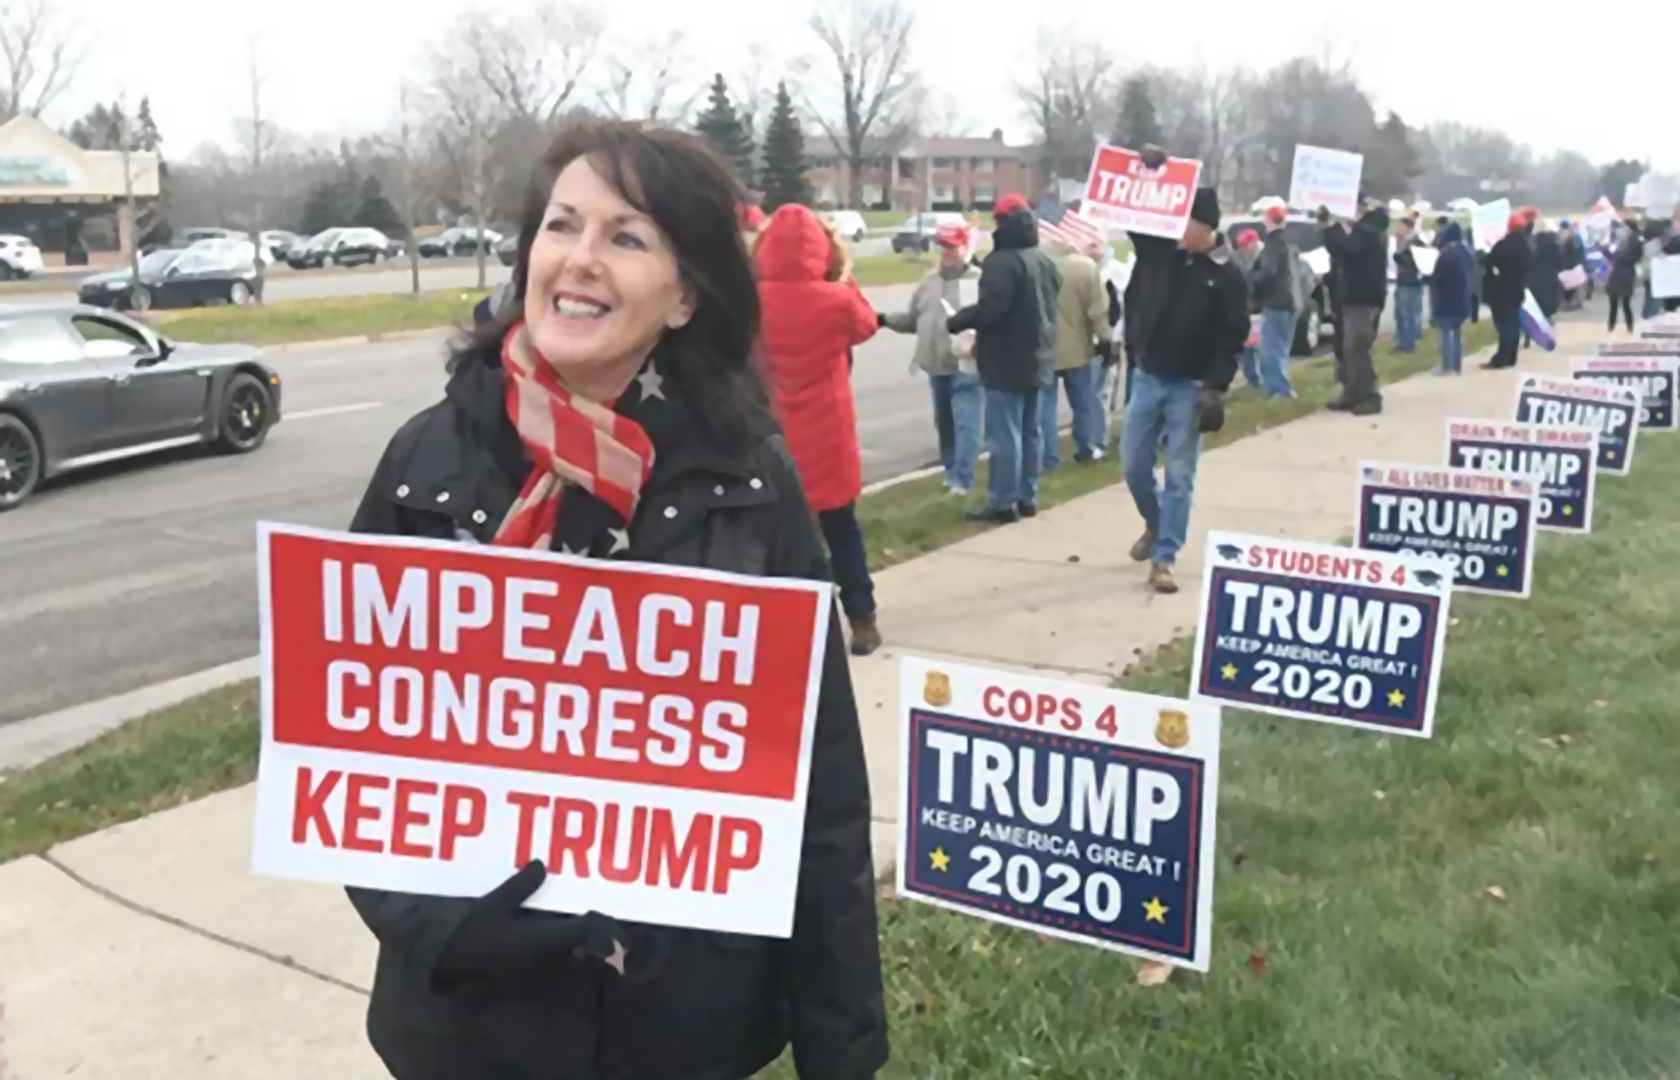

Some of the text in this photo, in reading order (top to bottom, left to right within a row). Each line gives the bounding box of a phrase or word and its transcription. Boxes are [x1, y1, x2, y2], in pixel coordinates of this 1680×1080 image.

[1099, 169, 1187, 211] TRUMP
[1526, 396, 1626, 434] TRUMP
[1458, 446, 1581, 485] TRUMP
[1372, 493, 1518, 541] TRUMP
[1248, 545, 1406, 586] STUDENTS 4
[322, 558, 760, 686] IMPEACH
[1224, 580, 1422, 655] TRUMP
[1216, 634, 1262, 654] KEEP
[1263, 642, 1342, 667] AMERICA
[1347, 654, 1407, 676] GREAT
[1251, 660, 1373, 709] 2020
[326, 659, 747, 772] CONGRESS
[983, 686, 1118, 738] COPS 4
[926, 728, 1181, 846] TRUMP
[291, 766, 763, 894] KEEP TRUMP
[921, 807, 977, 834] KEEP
[979, 821, 1081, 860] AMERICA
[1086, 843, 1167, 877] GREAT
[967, 845, 1122, 922] 2020
